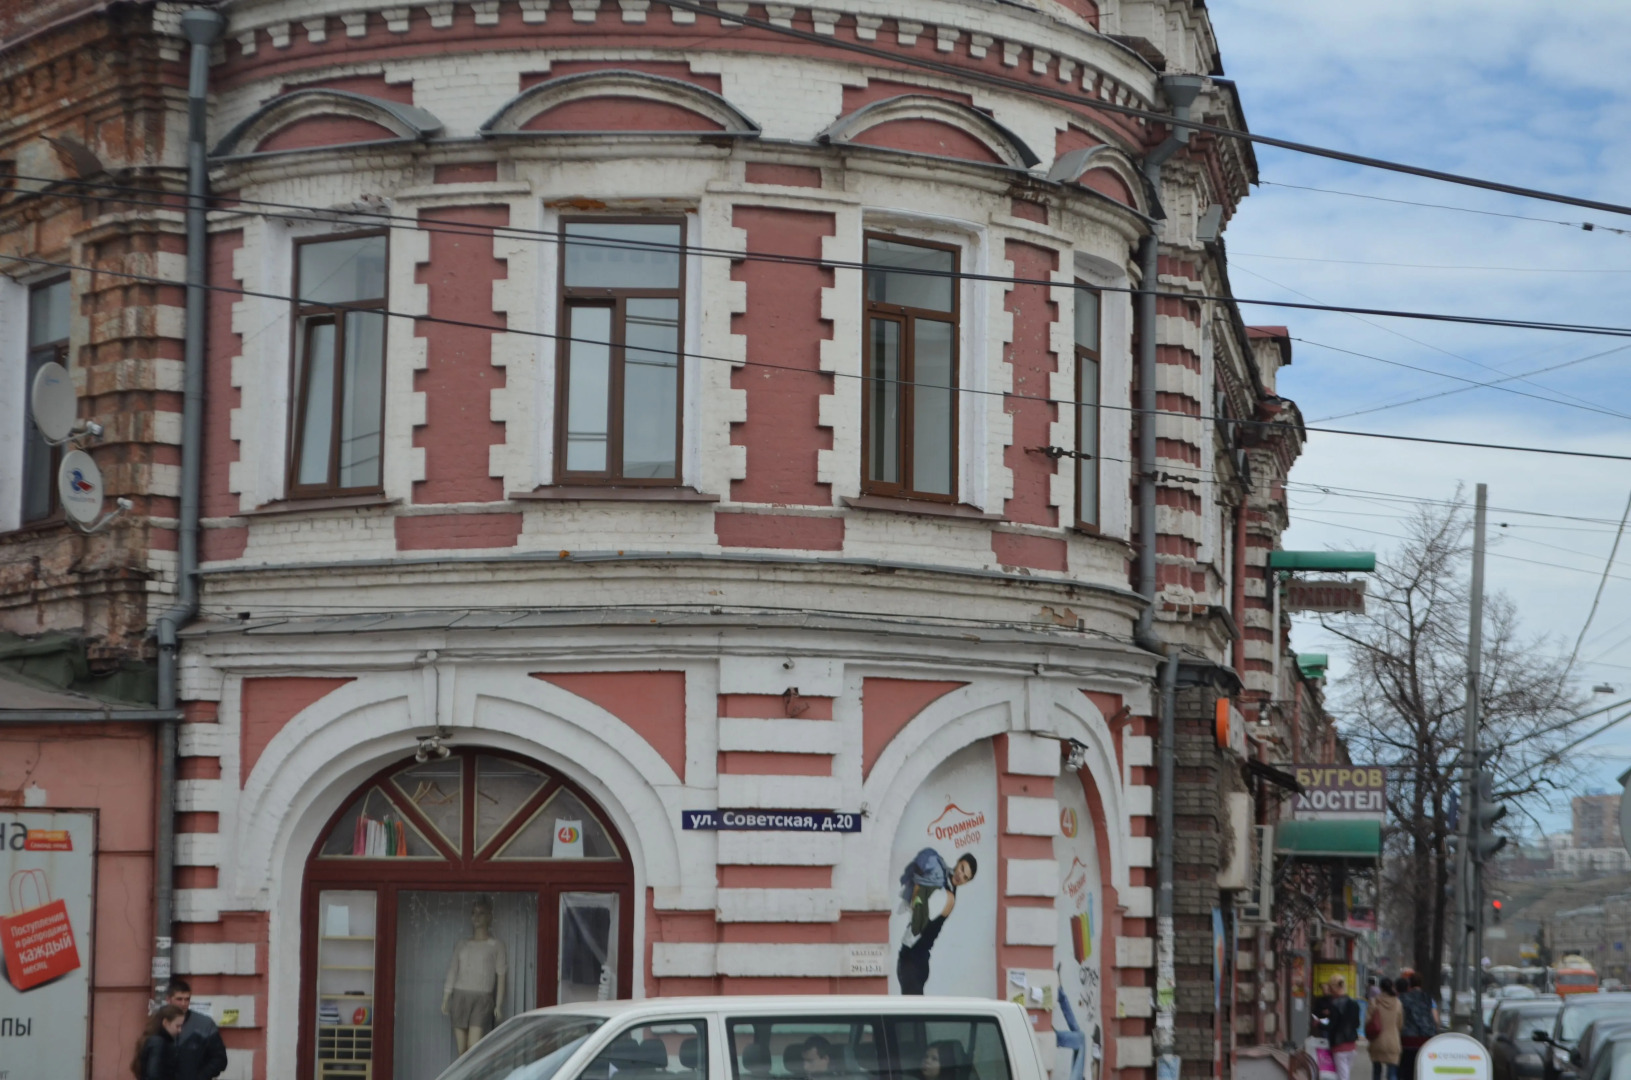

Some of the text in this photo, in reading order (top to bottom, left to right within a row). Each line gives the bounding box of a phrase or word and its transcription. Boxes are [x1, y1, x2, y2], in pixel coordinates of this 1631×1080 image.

[1297, 768, 1383, 787] БУГРОВ
[1297, 790, 1383, 809] ХОСТЕЛ
[690, 811, 853, 831] ул. Советская, д.20
[935, 811, 985, 840] Огромный
[560, 827, 570, 841] 4
[954, 830, 981, 848] выбор
[11, 912, 65, 937] Поступления
[19, 932, 72, 964] каждый
